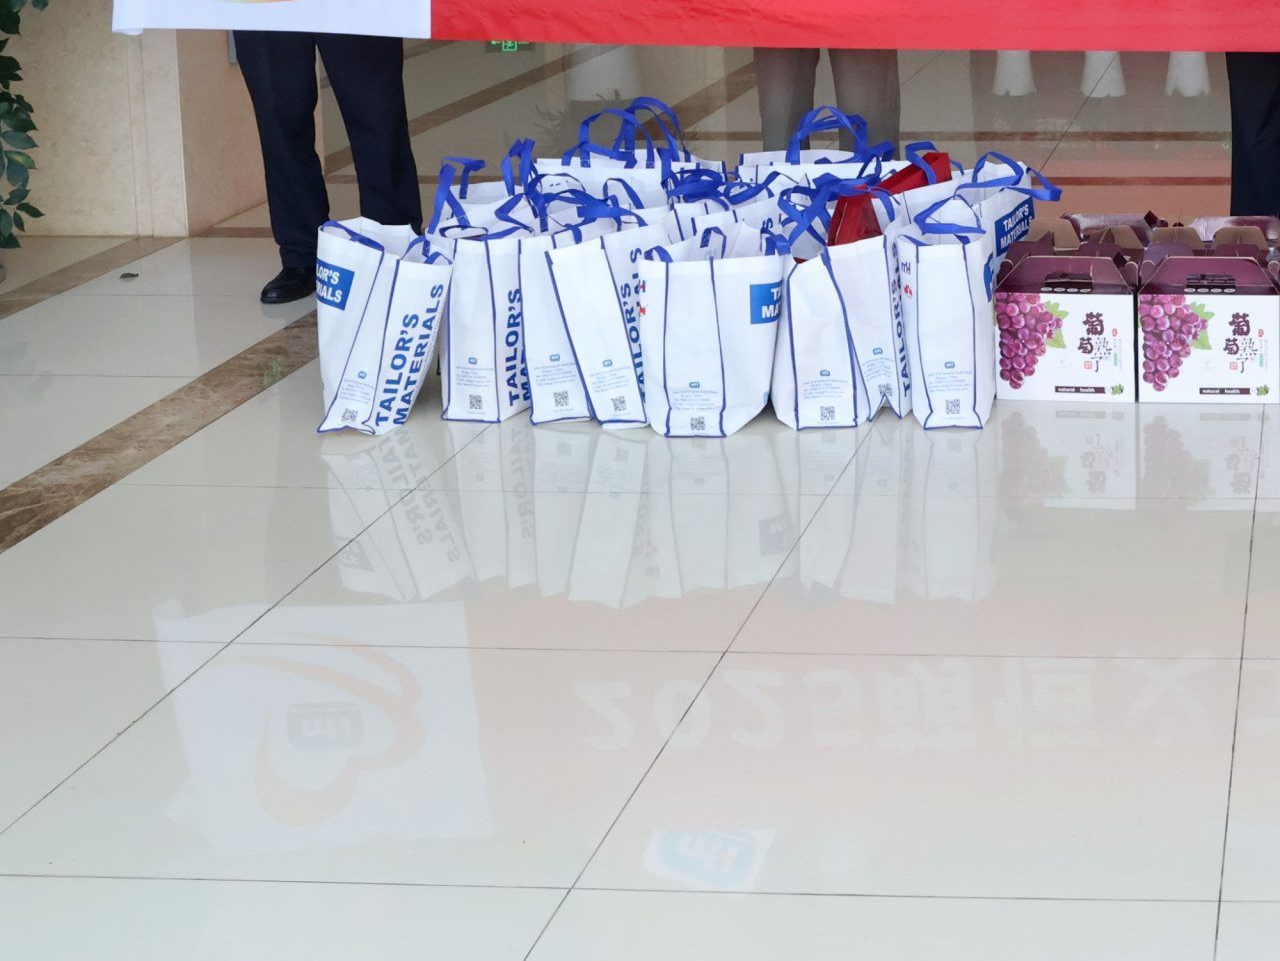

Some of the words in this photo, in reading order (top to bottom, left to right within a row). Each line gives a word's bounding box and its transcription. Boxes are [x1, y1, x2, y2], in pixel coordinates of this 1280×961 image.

[316, 265, 340, 285] LOR'S
[375, 313, 420, 427] TAILOR'S
[393, 283, 445, 425] MATERIALS
[505, 288, 523, 407] TAILOR'S
